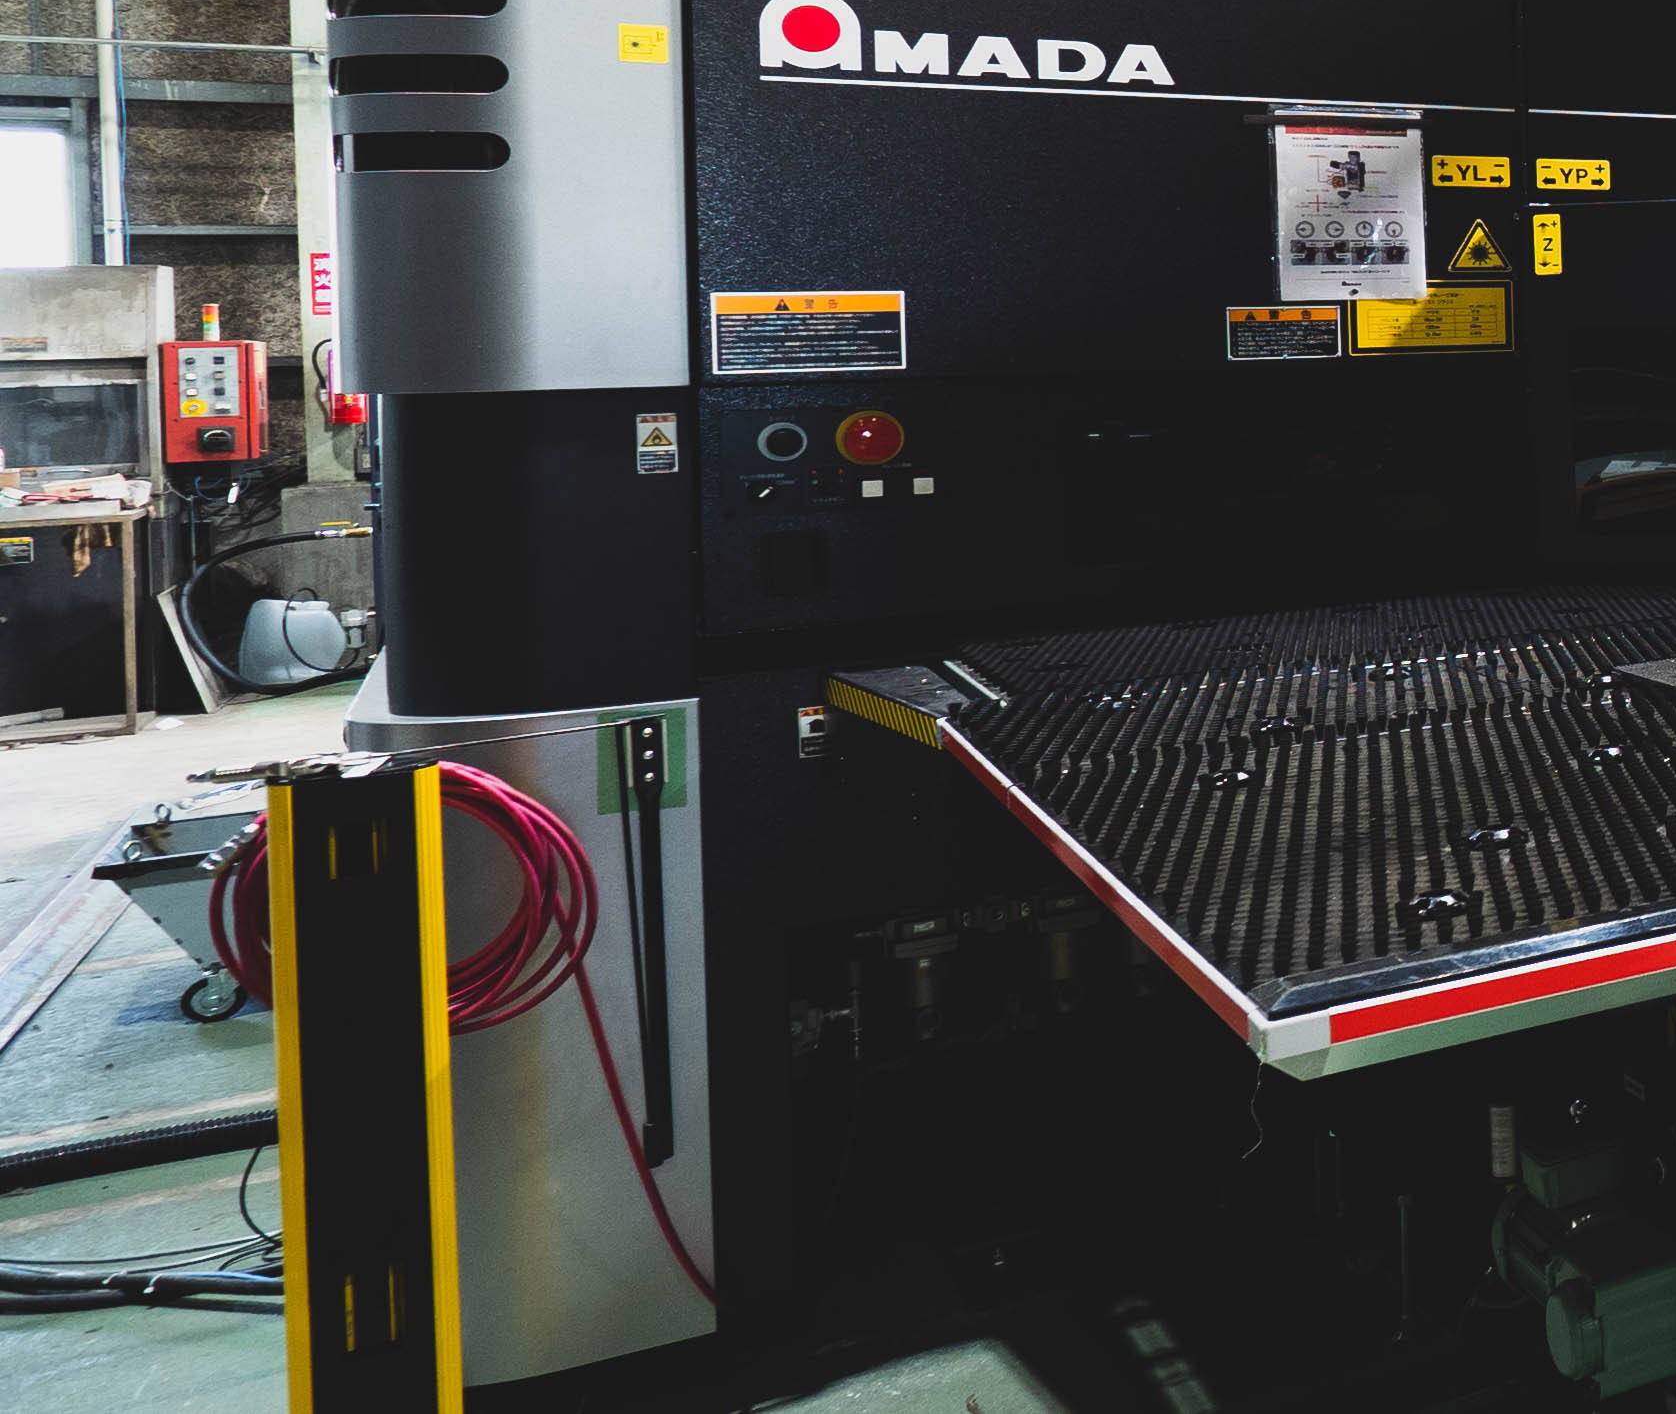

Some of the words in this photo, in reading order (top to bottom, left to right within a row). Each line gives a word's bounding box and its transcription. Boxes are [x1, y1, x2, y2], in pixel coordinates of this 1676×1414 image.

[1456, 164, 1487, 183] YL
[1559, 167, 1589, 184] YP
[1543, 237, 1554, 252] Z
